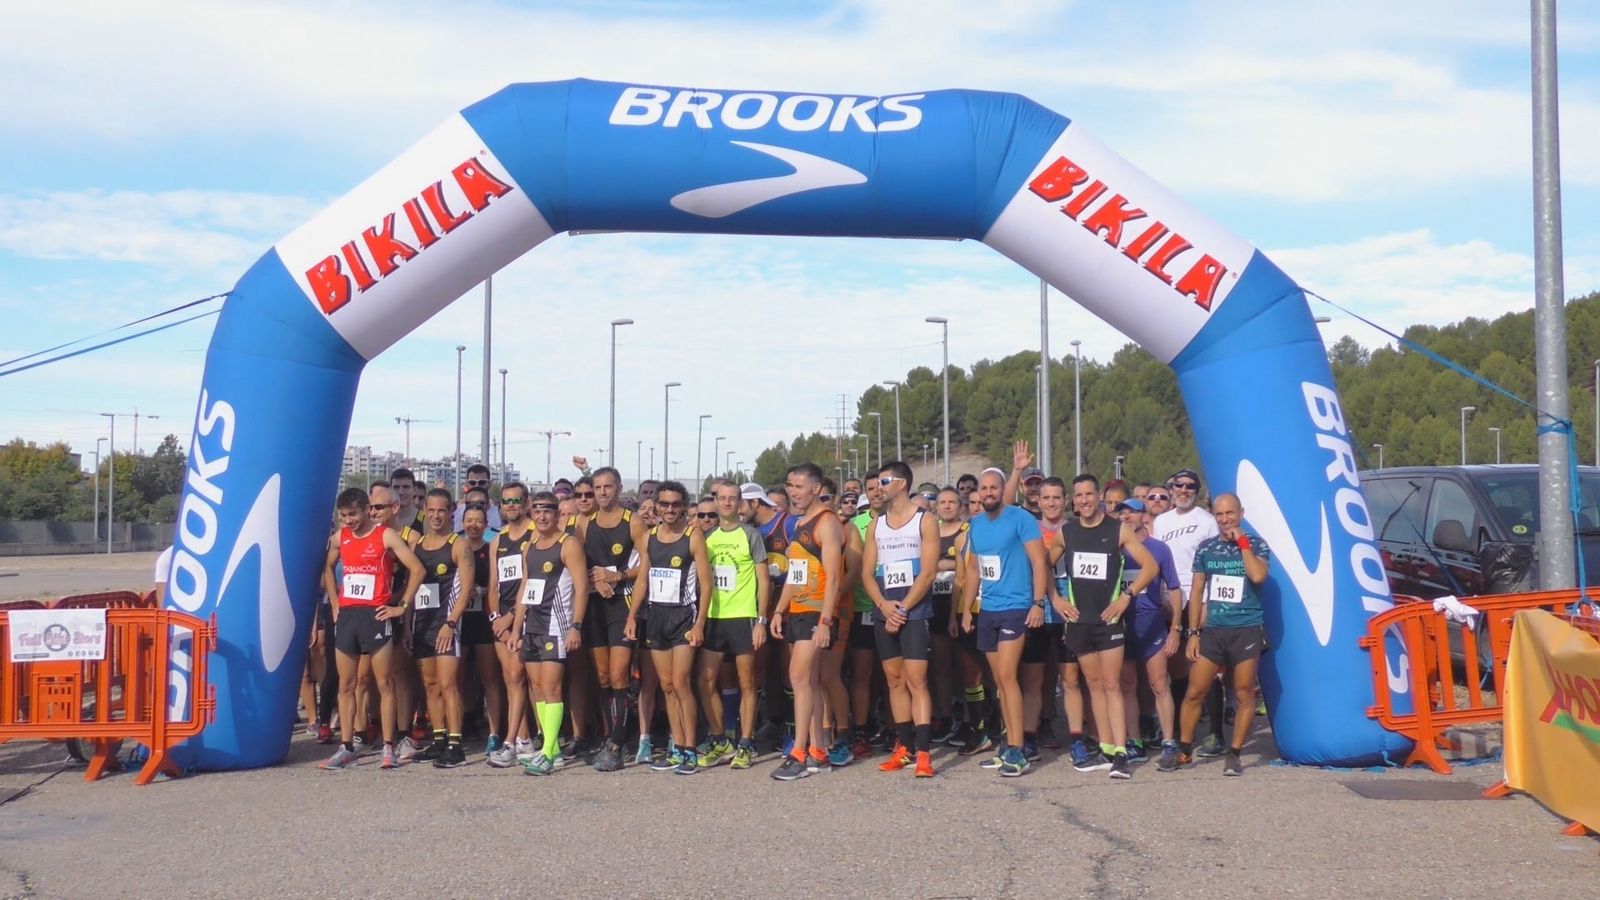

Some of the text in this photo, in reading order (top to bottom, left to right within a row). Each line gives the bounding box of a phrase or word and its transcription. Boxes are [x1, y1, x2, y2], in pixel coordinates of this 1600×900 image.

[608, 86, 926, 133] BROOKS
[305, 156, 514, 315] BIKILA
[1028, 155, 1228, 313] BIKILA
[503, 565, 517, 578] 267
[1080, 563, 1099, 576] 242
[713, 575, 728, 587] 211
[887, 572, 907, 585] 234
[350, 584, 366, 596] 187
[527, 590, 536, 601] 44
[1217, 586, 1235, 599] 163
